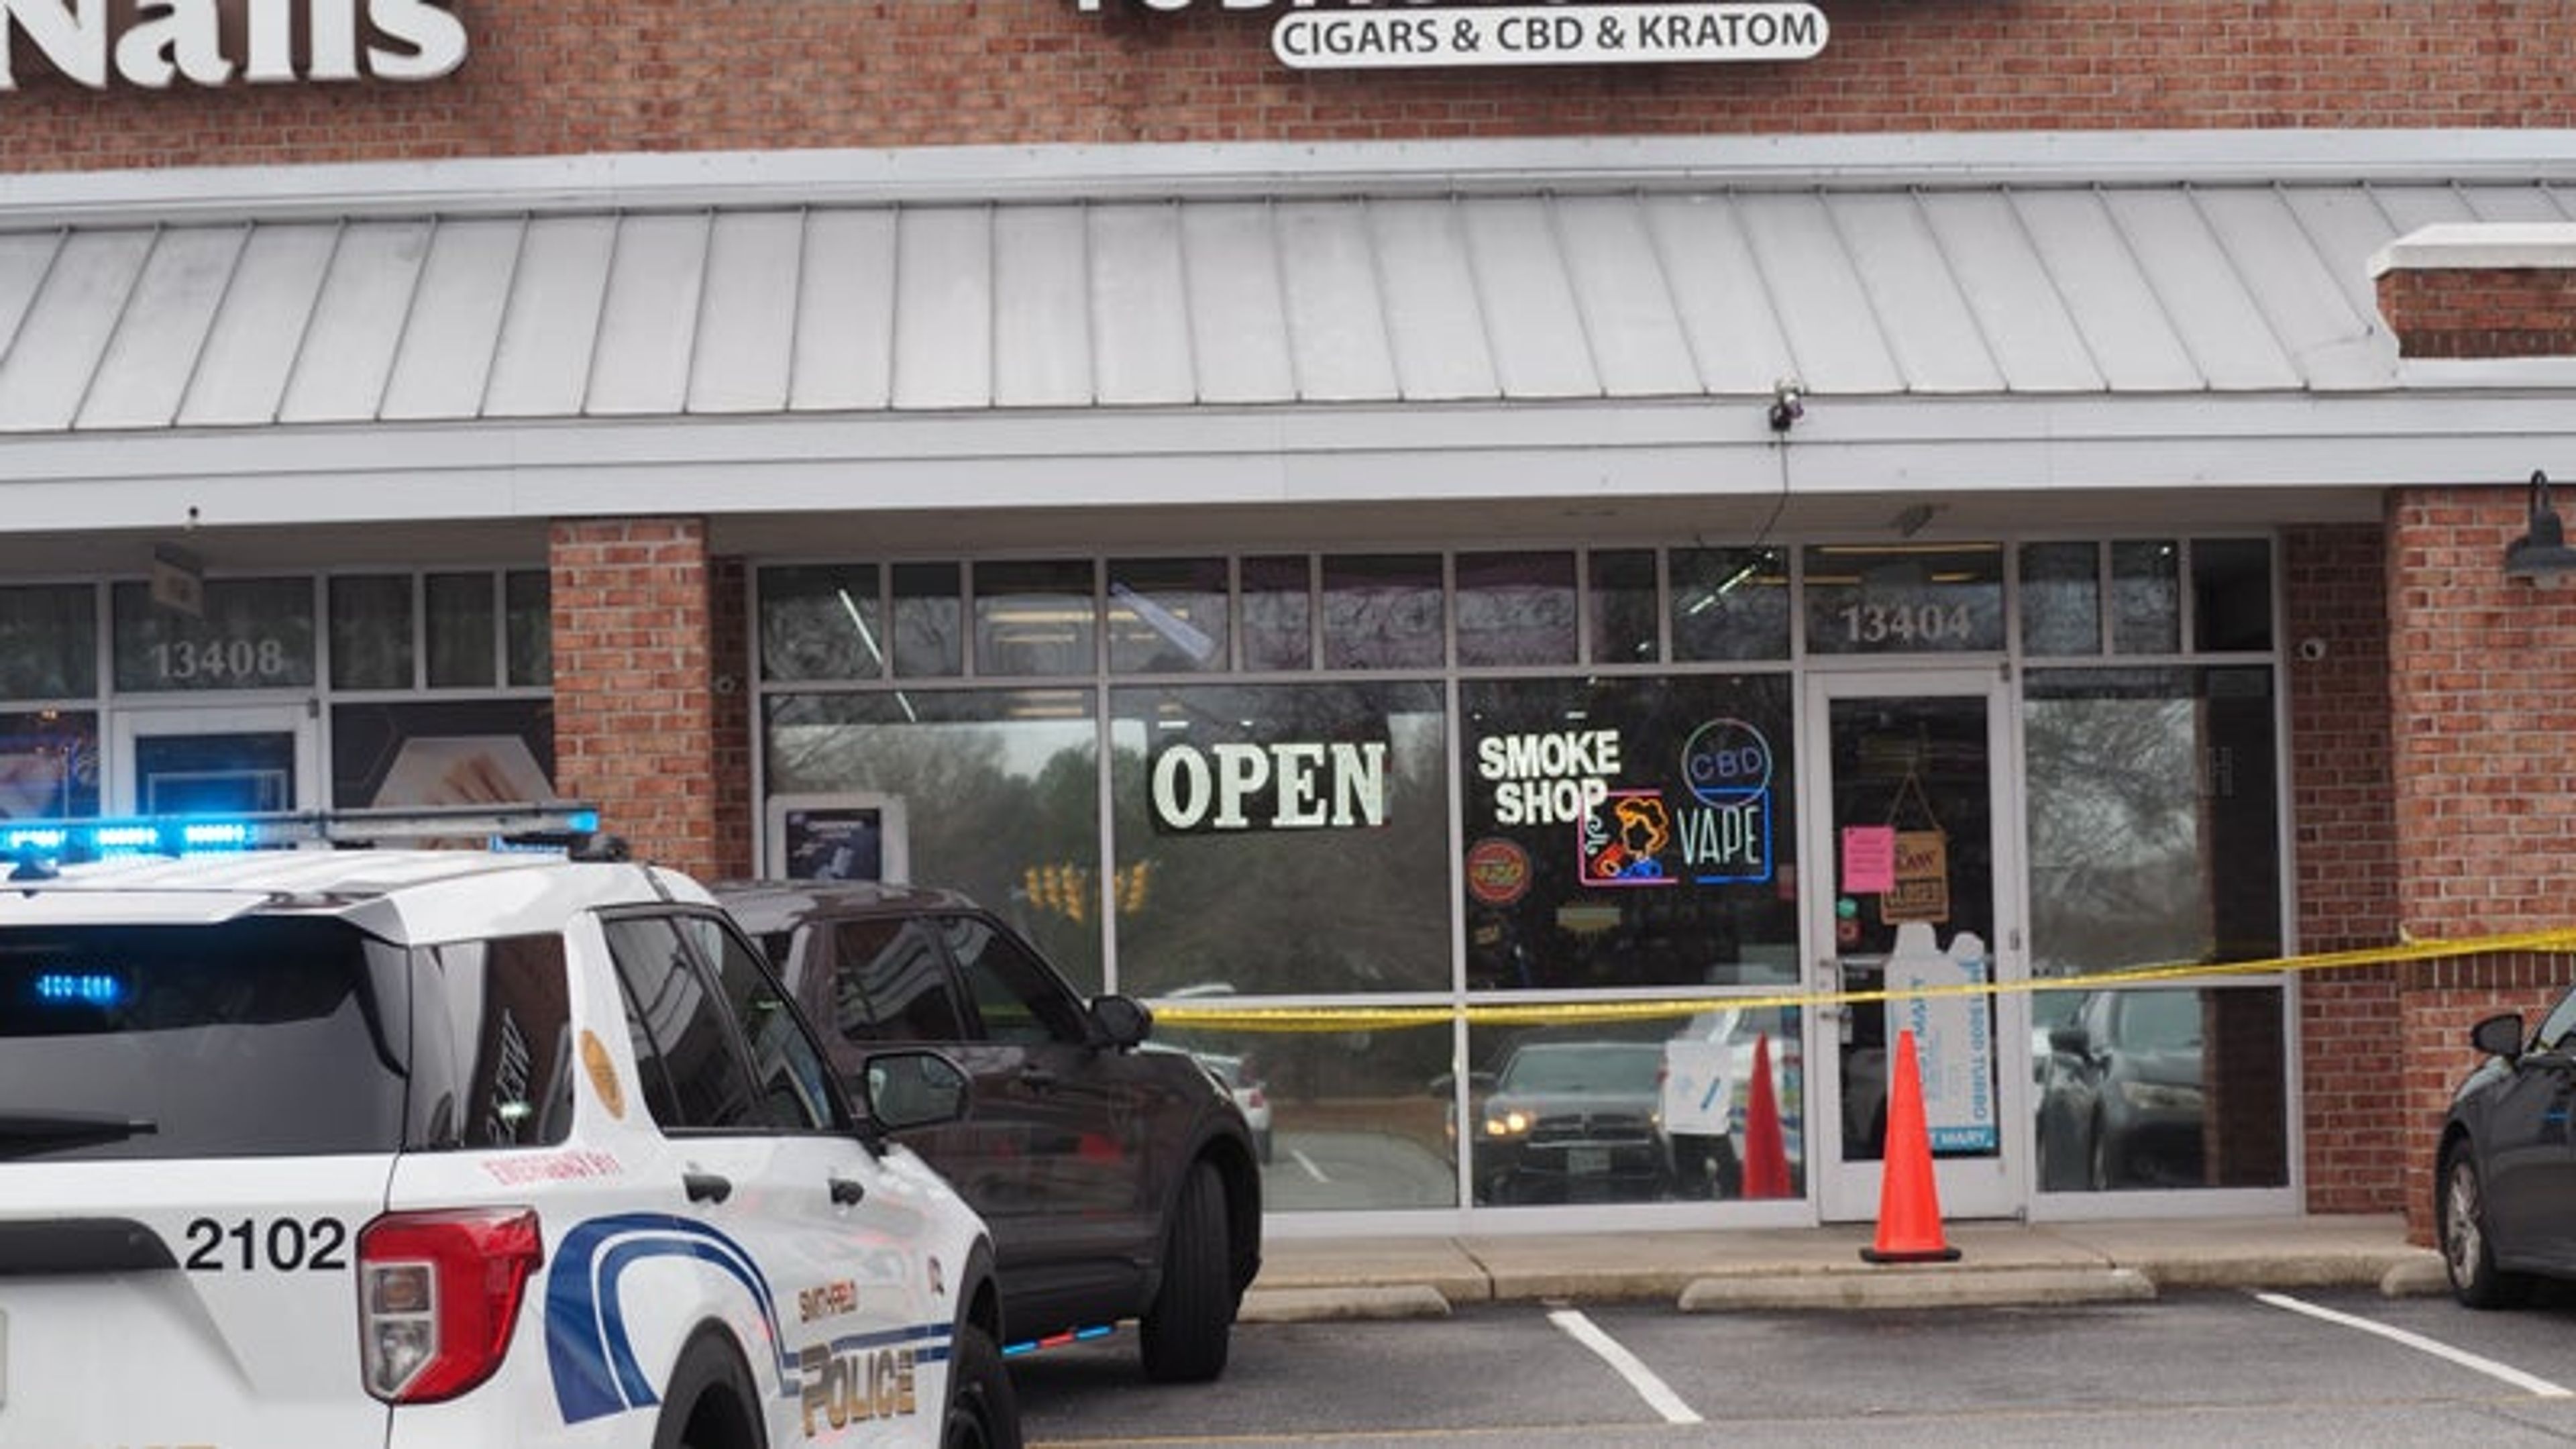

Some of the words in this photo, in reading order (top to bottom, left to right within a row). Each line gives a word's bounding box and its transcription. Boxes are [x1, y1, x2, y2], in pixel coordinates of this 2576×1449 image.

[1282, 19, 1438, 56] CIGARS
[1451, 18, 1480, 52] &
[1497, 16, 1583, 50] CBD
[1597, 15, 1625, 48] &
[1639, 13, 1817, 48] KRATOM
[1838, 603, 1972, 642] 13404
[152, 640, 283, 678] 13408
[1478, 730, 1621, 780] SMOKE
[1690, 746, 1763, 780] CBD
[1152, 743, 1387, 829] OPEN
[1495, 777, 1608, 825] SHOP
[1677, 805, 1762, 865] VAPE
[186, 1217, 346, 1272] 2102
[800, 1342, 916, 1438] POLICE
